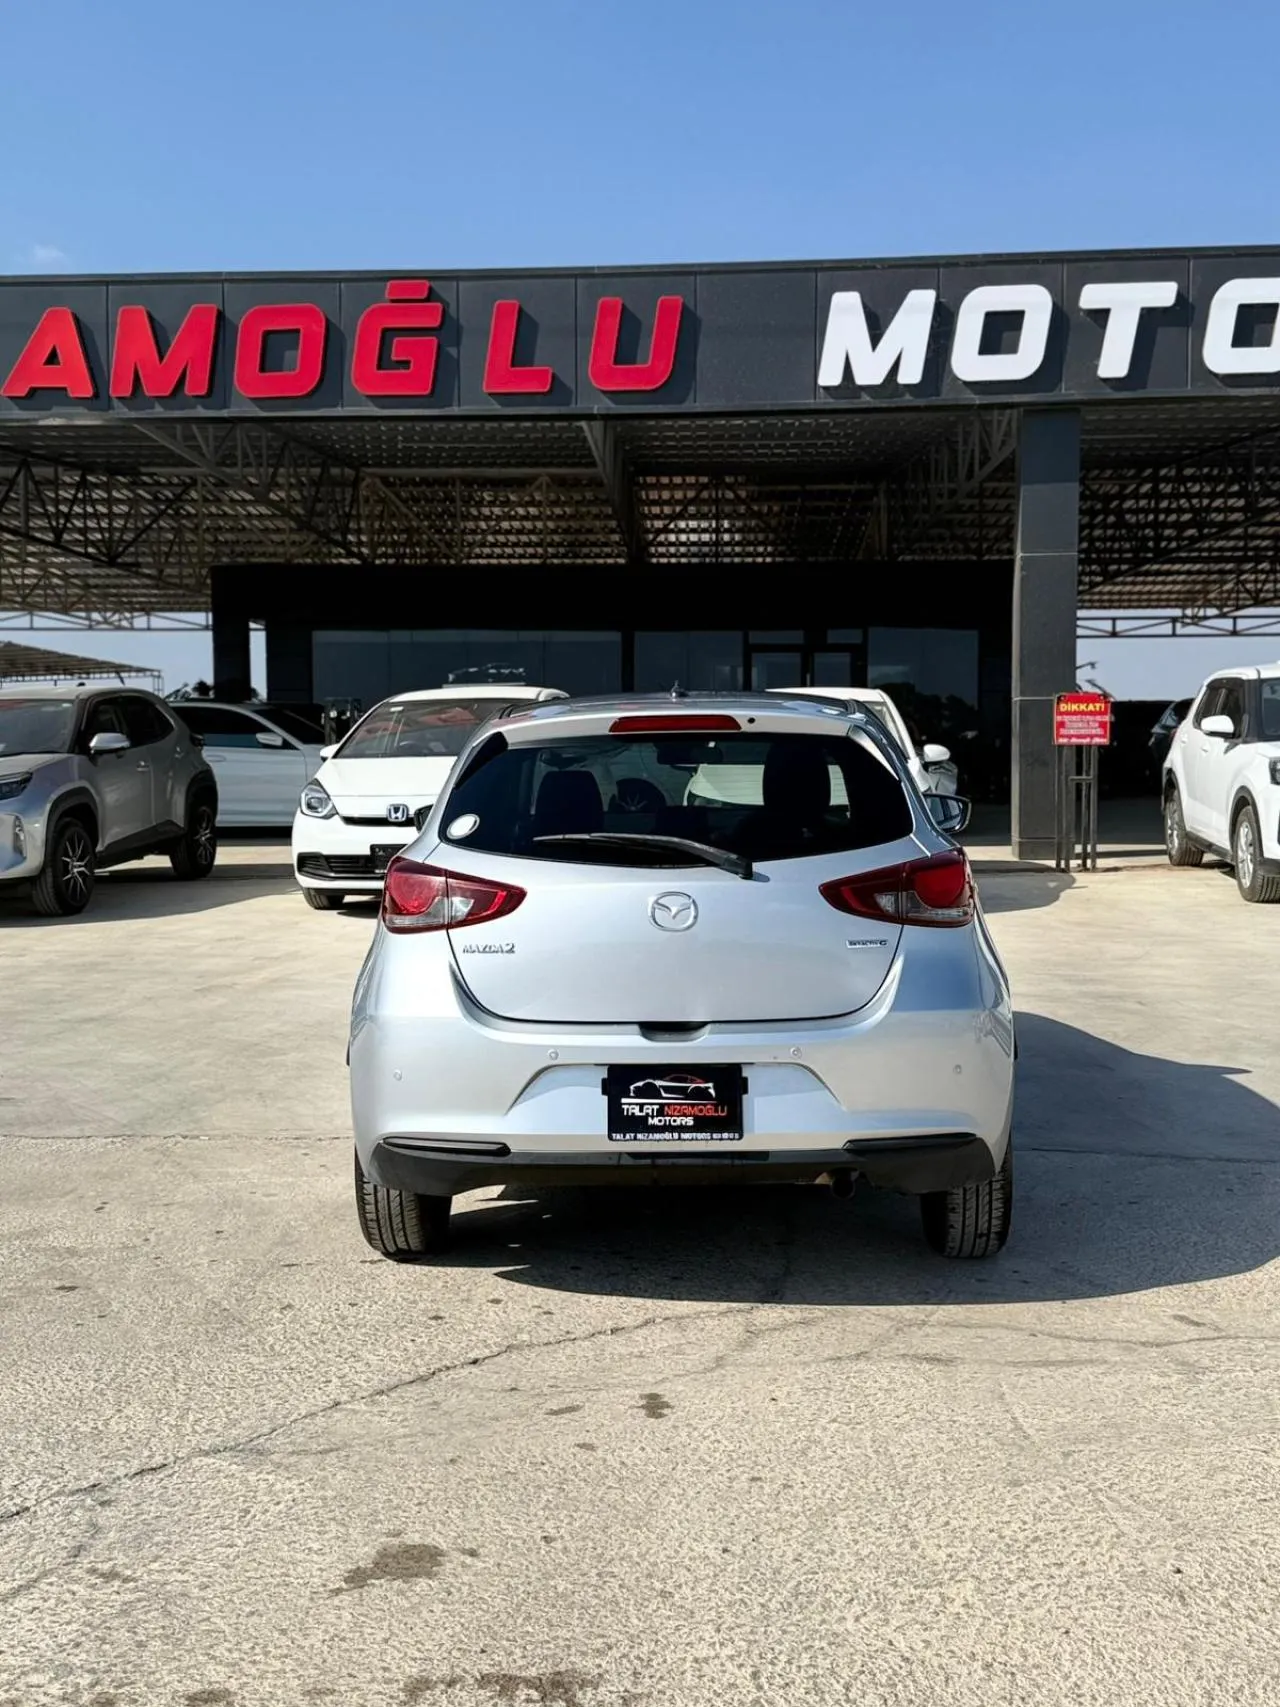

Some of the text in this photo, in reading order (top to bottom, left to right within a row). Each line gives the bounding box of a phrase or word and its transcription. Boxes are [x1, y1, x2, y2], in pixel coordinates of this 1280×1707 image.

[1, 276, 1280, 398] AMOĞLU MOTO
[622, 1105, 659, 1116] TALAT
[648, 1116, 694, 1126] MOTORS
